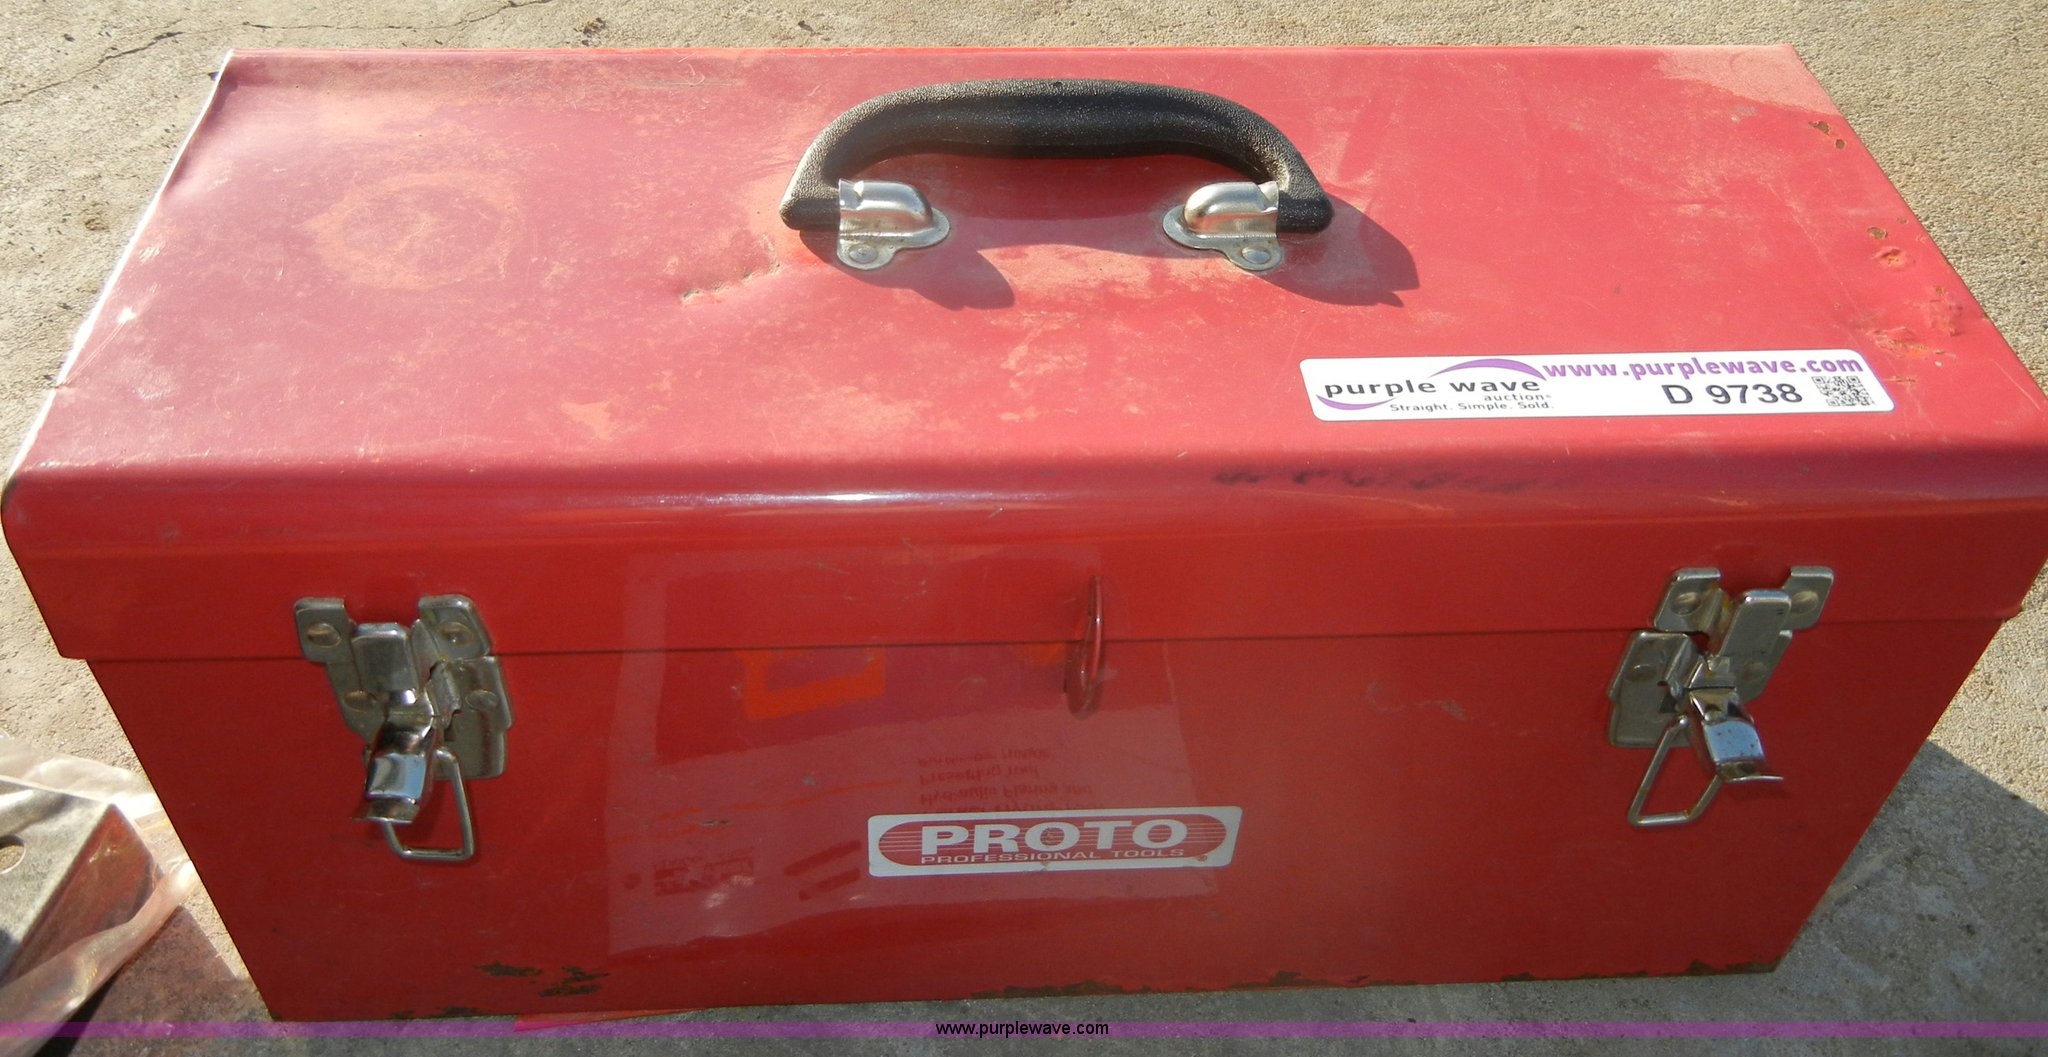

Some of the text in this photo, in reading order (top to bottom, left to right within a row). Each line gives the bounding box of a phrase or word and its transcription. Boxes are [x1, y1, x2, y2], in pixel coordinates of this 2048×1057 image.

[1541, 357, 1864, 381] www.purplewave.com
[1324, 379, 1541, 398] purple wave
[1661, 383, 1803, 405] D 9738
[1390, 401, 1555, 413] Straight. Simple. Sold.
[921, 818, 1189, 856] PROTO
[921, 848, 1185, 864] PROFESSIONAL TOOLS
